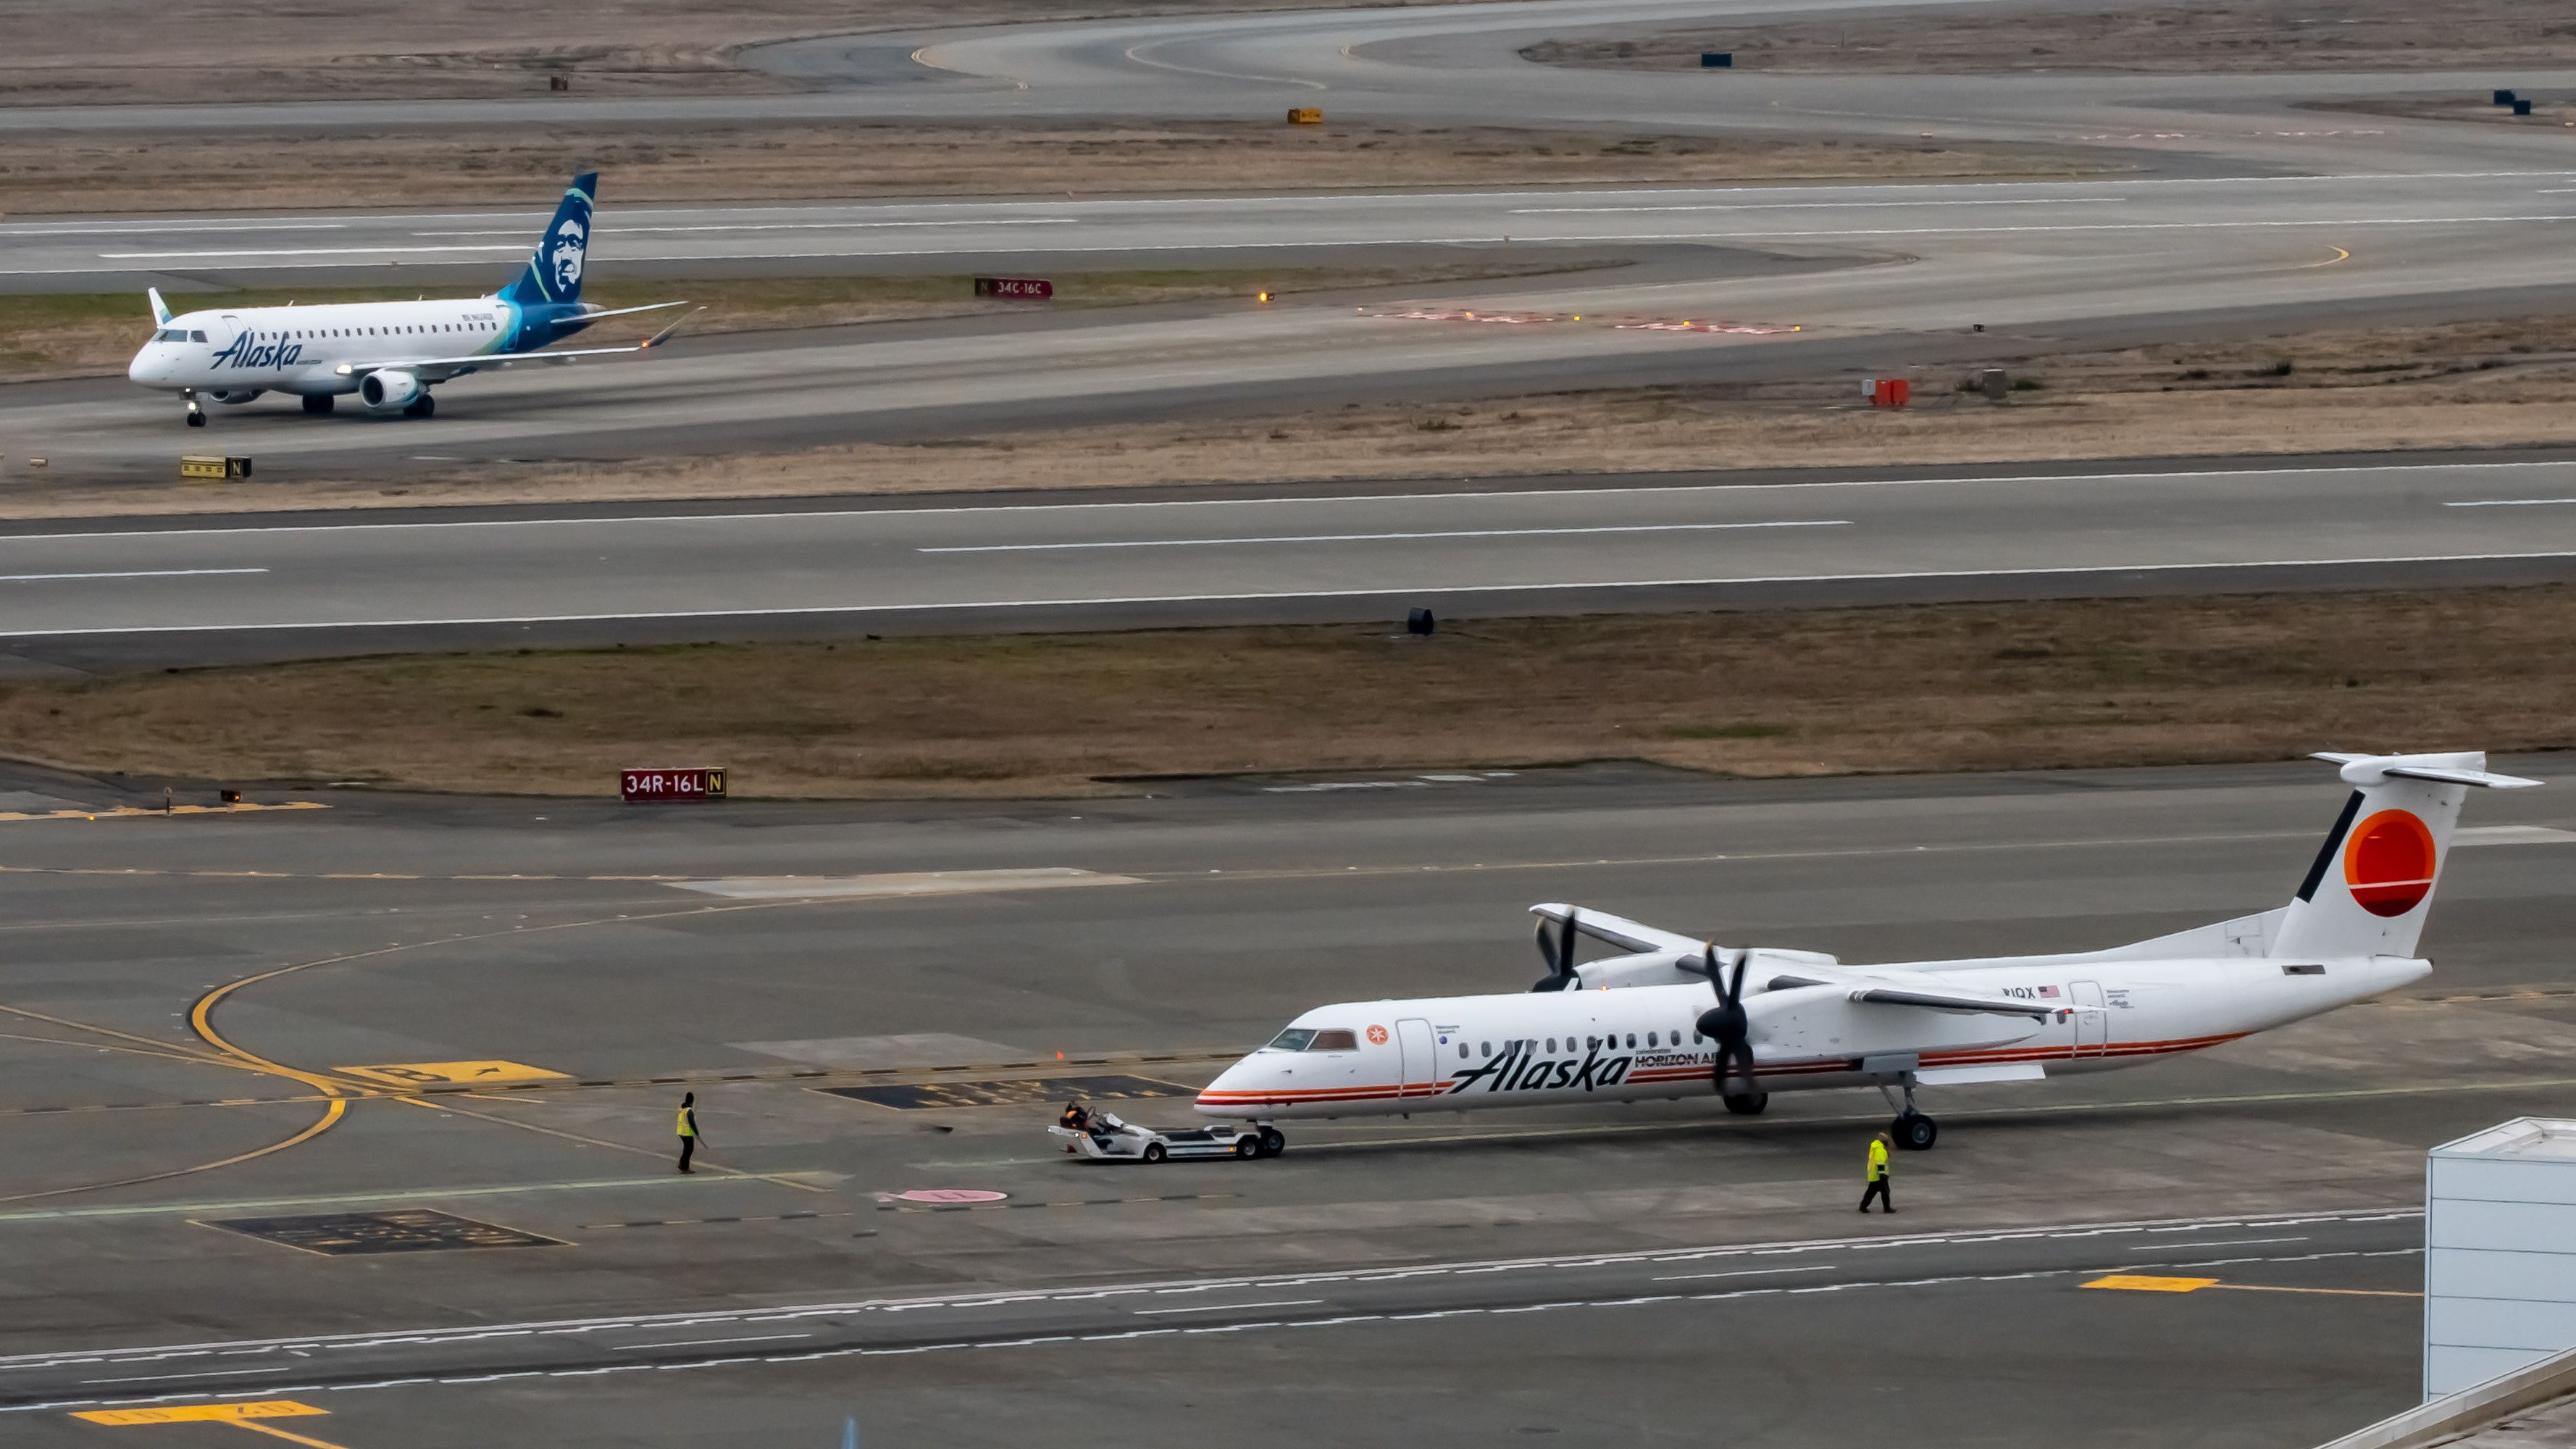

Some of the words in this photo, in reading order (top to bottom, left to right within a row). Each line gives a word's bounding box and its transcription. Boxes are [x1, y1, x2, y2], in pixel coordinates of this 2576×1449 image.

[998, 282, 1042, 294] 34C-16C
[209, 330, 303, 372] Alaska
[233, 461, 241, 475] N
[626, 774, 704, 793] 34R-16L
[710, 774, 722, 790] N
[1447, 1038, 1634, 1094] Alaska
[1635, 1053, 1699, 1068] HORIZON
[366, 1067, 453, 1082] B
